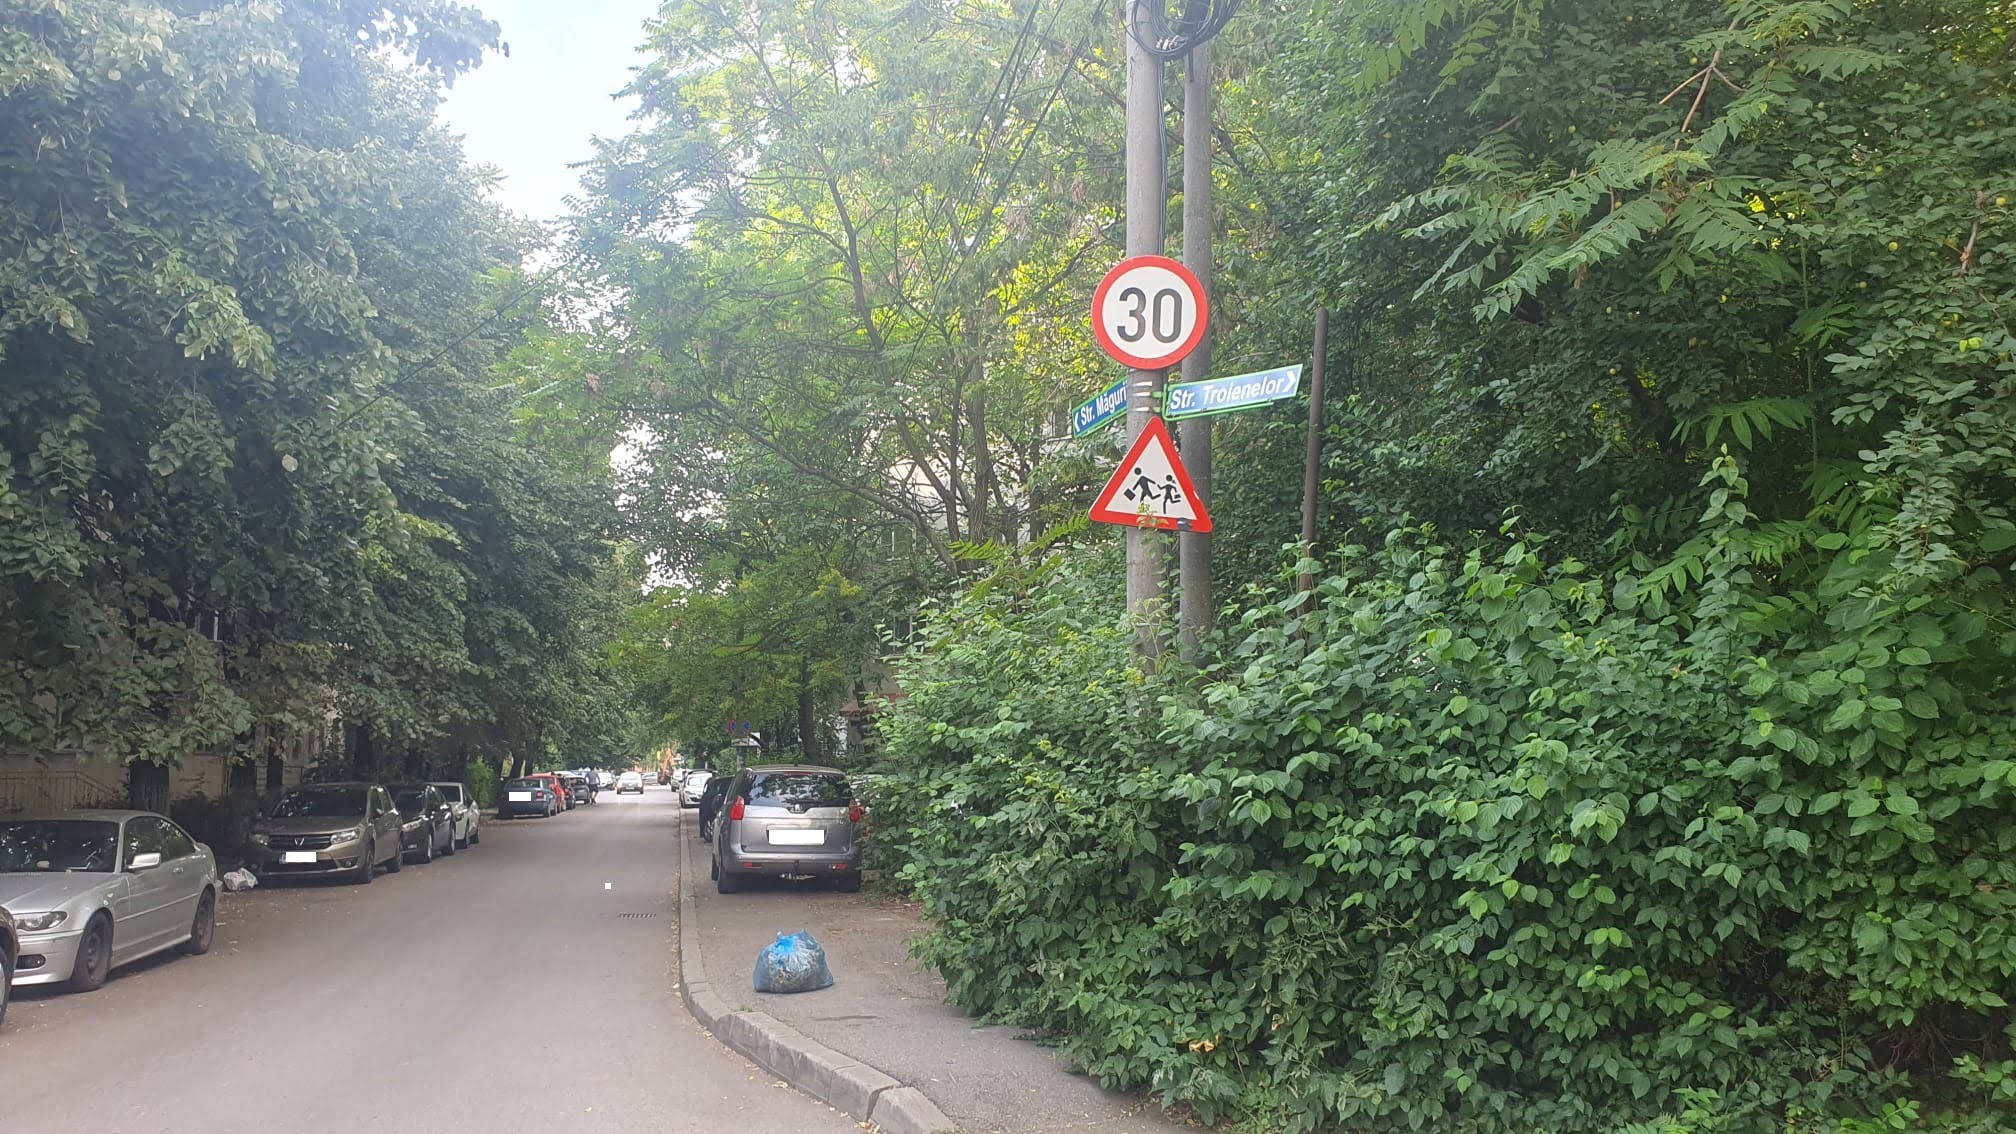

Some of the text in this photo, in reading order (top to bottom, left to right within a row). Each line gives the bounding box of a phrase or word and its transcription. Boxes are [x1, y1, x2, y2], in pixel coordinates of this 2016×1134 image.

[1117, 287, 1183, 344] 30
[1080, 380, 1128, 426] Str. Măguri
[1170, 375, 1285, 410] Str. Troienelor
